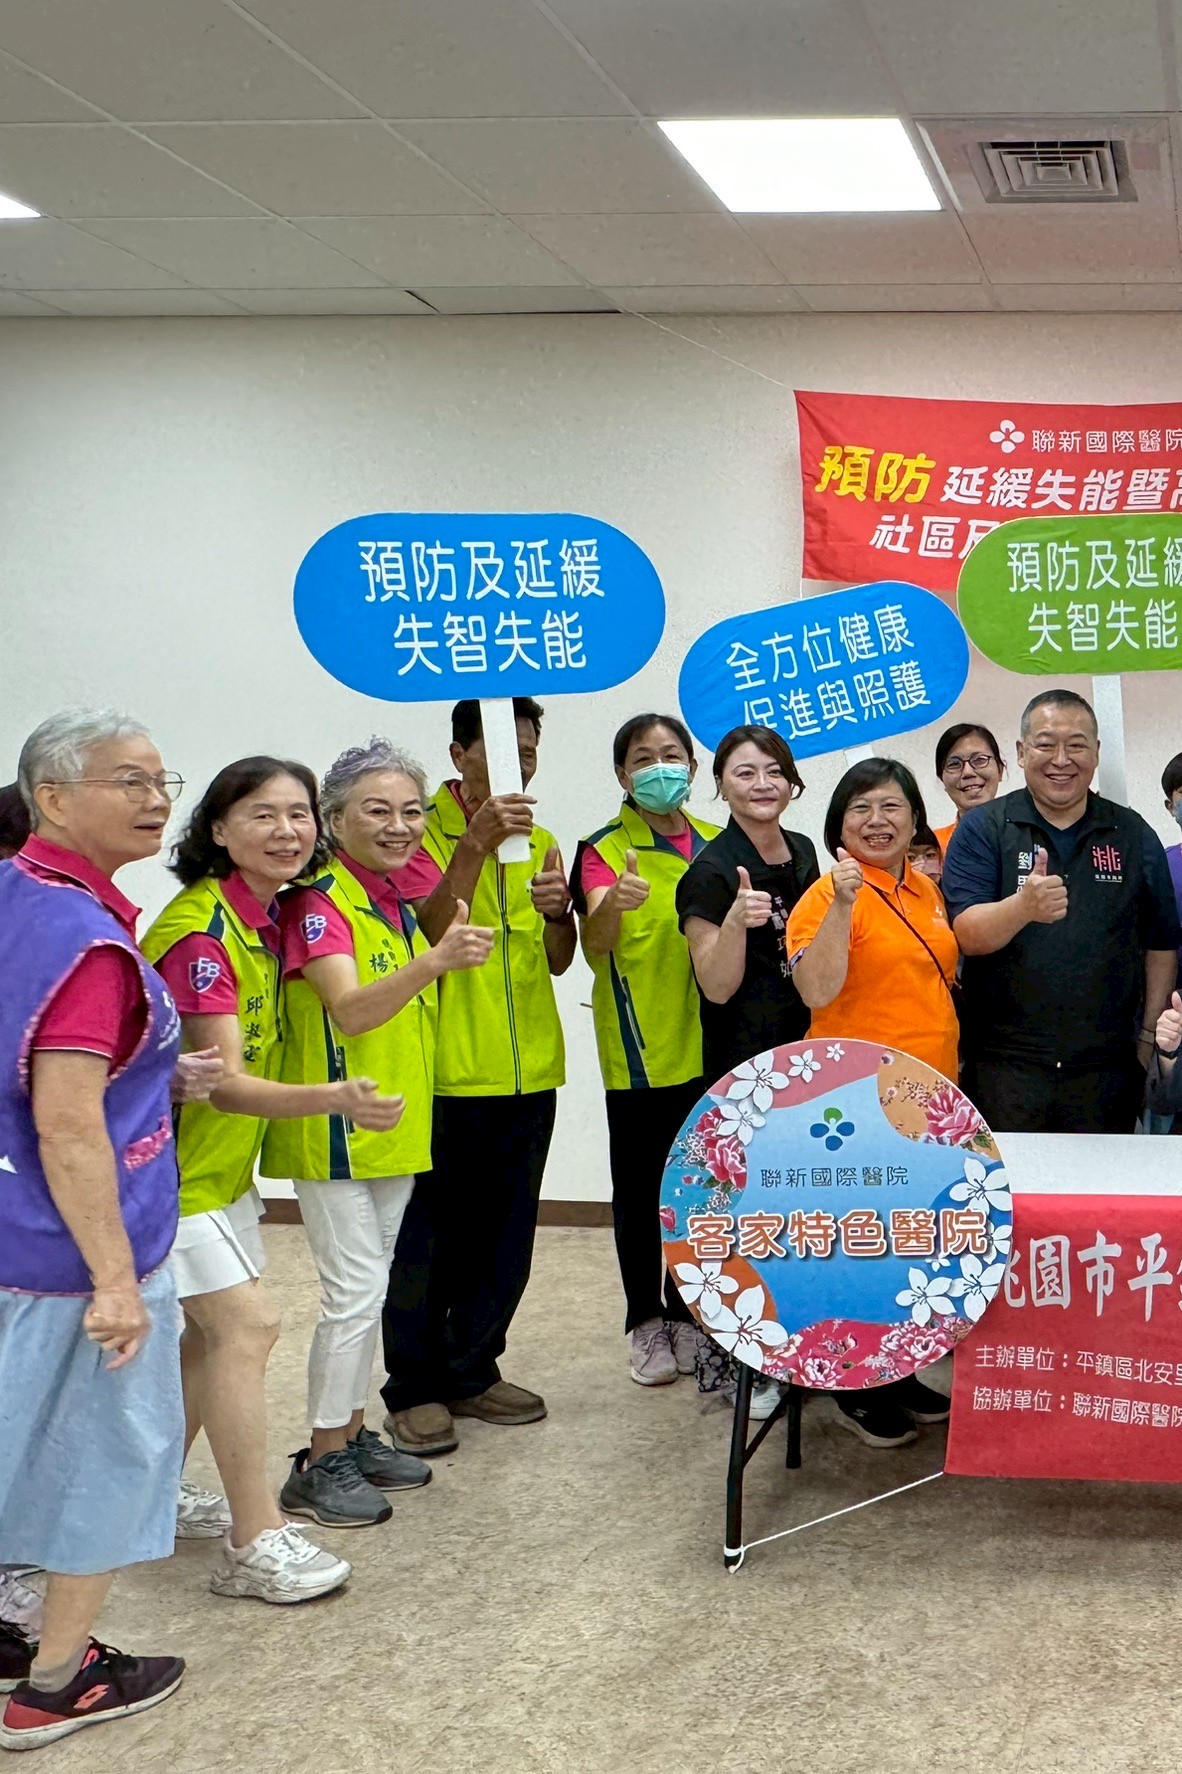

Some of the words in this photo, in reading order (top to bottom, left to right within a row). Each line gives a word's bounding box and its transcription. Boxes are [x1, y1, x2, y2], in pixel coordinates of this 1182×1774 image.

[815, 445, 936, 504] 預防
[358, 538, 606, 603] 預防及延緩
[393, 610, 587, 676] 失智失能
[726, 603, 915, 691] 全方位健康
[1028, 598, 1179, 654] 失智失能
[743, 660, 931, 740] 促進與照護
[305, 914, 328, 930] FB
[198, 957, 221, 978] FB
[760, 1166, 909, 1189] 聯新國際醫院
[686, 1207, 989, 1260] 客家特色醫院
